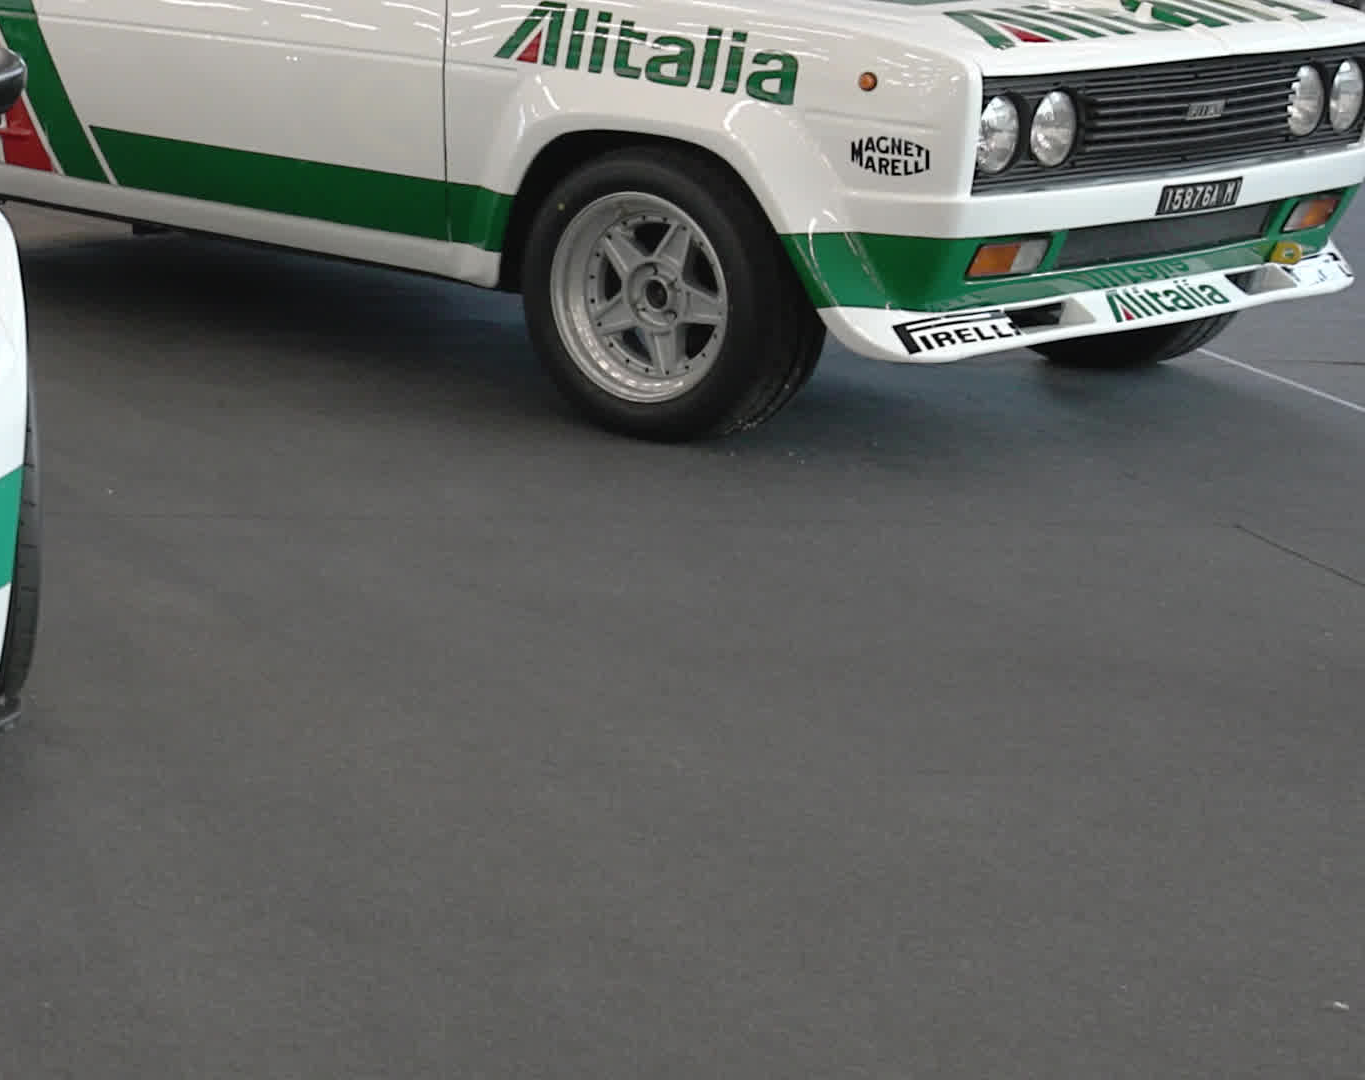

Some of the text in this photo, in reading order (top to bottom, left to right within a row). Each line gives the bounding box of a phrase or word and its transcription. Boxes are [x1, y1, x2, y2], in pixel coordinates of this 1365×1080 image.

[494, 0, 799, 106] Alitalia
[1103, 279, 1231, 323] Alitalia
[891, 309, 1020, 356] PIRELLI
